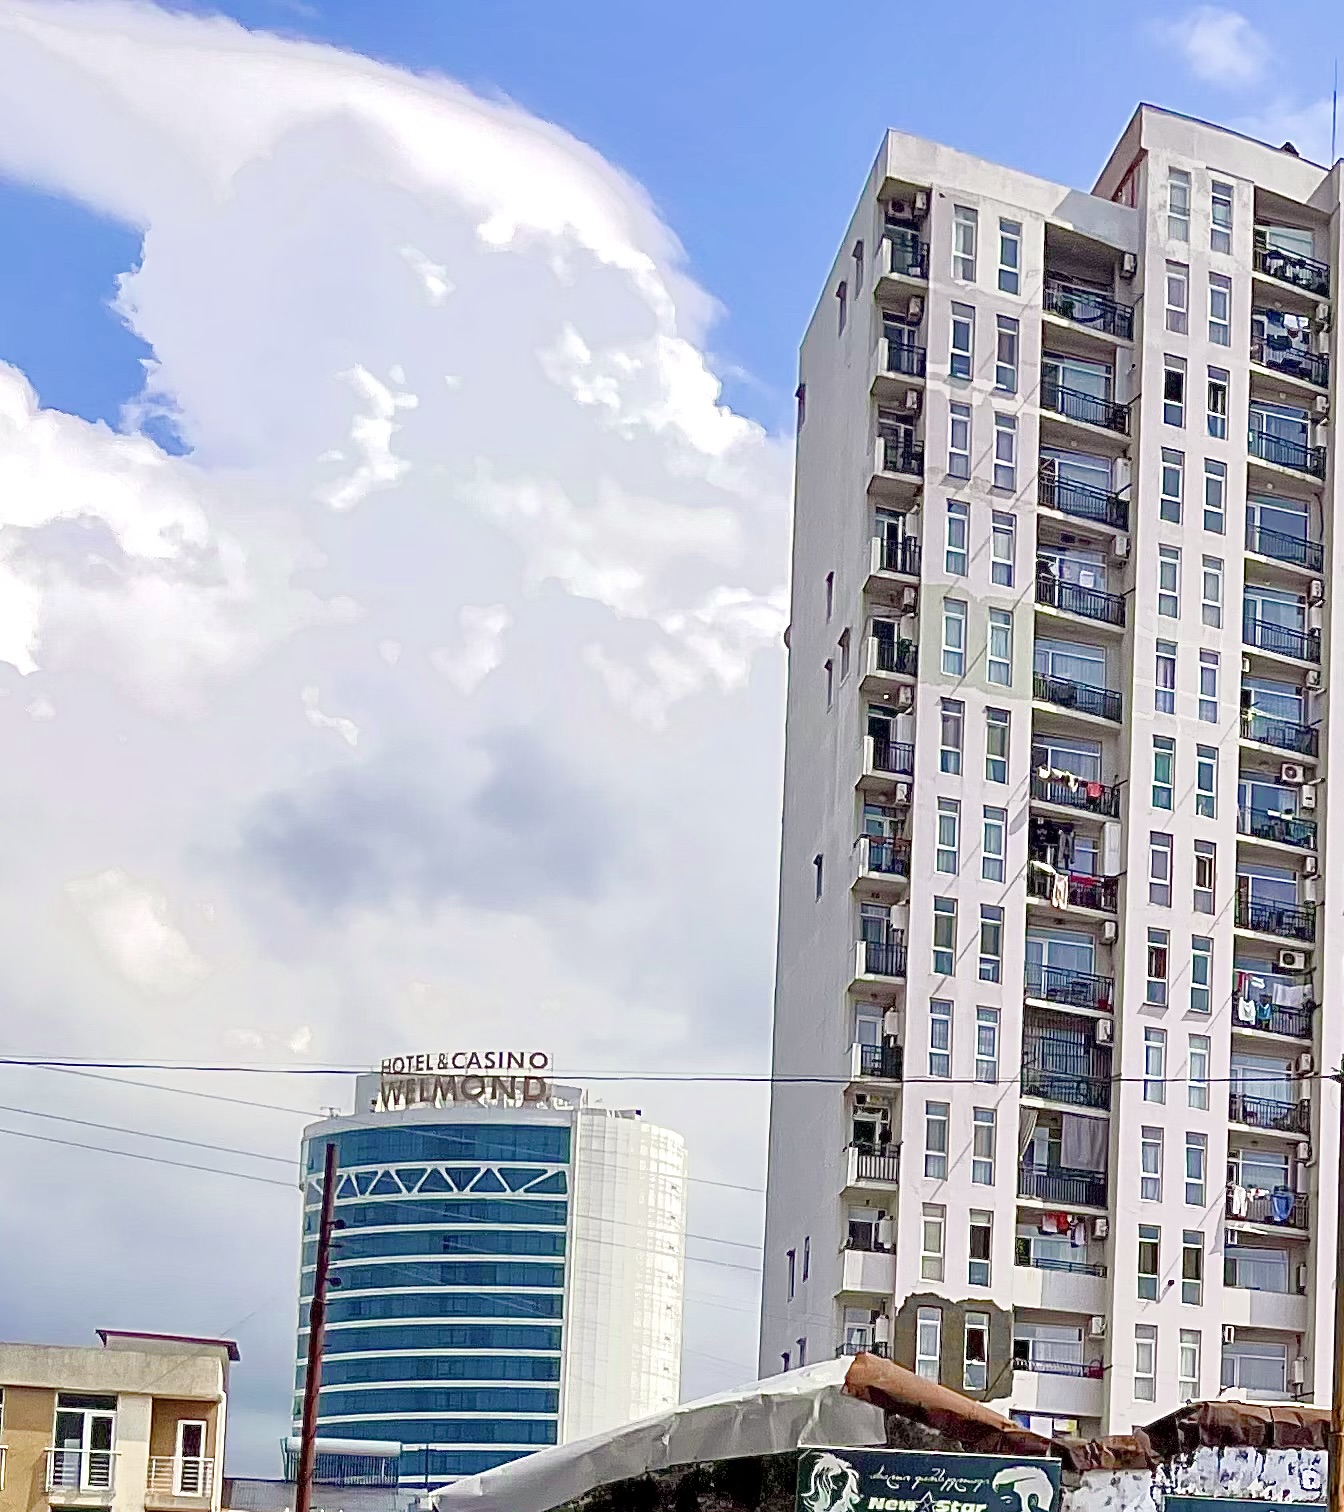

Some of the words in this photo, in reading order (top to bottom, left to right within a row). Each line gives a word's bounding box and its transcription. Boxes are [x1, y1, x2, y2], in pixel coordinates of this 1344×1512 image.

[381, 1053, 434, 1074] HOTEL
[437, 1052, 448, 1069] &
[452, 1051, 548, 1069] CASINO
[867, 1497, 916, 1512] New
